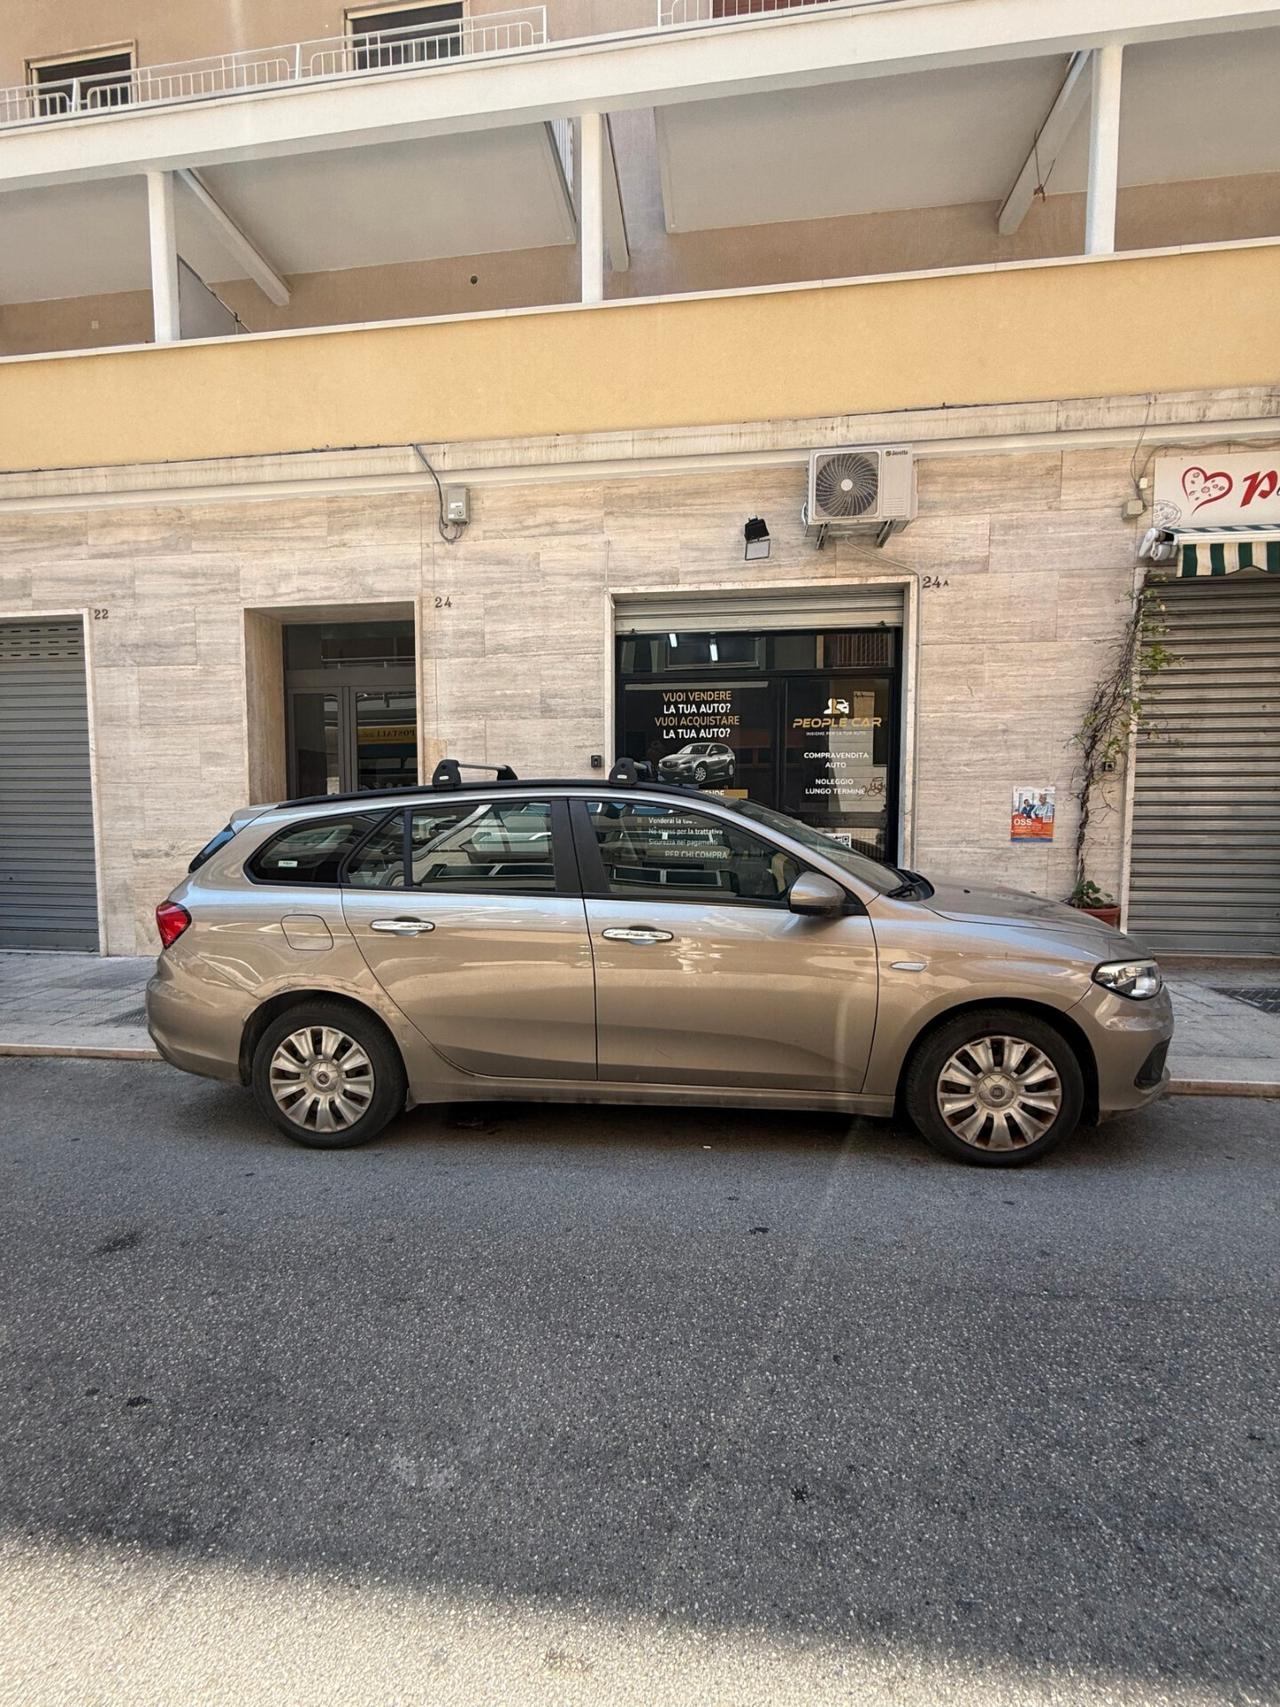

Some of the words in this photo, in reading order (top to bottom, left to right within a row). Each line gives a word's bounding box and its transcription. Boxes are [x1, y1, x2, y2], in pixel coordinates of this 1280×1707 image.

[435, 596, 453, 609] 24
[94, 608, 109, 620] 22
[662, 691, 686, 702] VUOI
[688, 690, 732, 702] VENDERE
[663, 704, 676, 714] LA
[678, 703, 697, 714] TUA
[699, 703, 731, 714] AUTO?
[655, 716, 678, 726] VUOI
[680, 715, 740, 727] ACQUISTARE
[793, 717, 848, 728] PEOPLE
[851, 717, 882, 728] CAR
[663, 729, 676, 739] LA
[677, 728, 697, 739] TUA
[699, 727, 731, 739] AUTO?
[803, 751, 870, 759] COMPRAVENDITA
[1013, 818, 1032, 826] OSS
[694, 850, 728, 859] COMPRA
